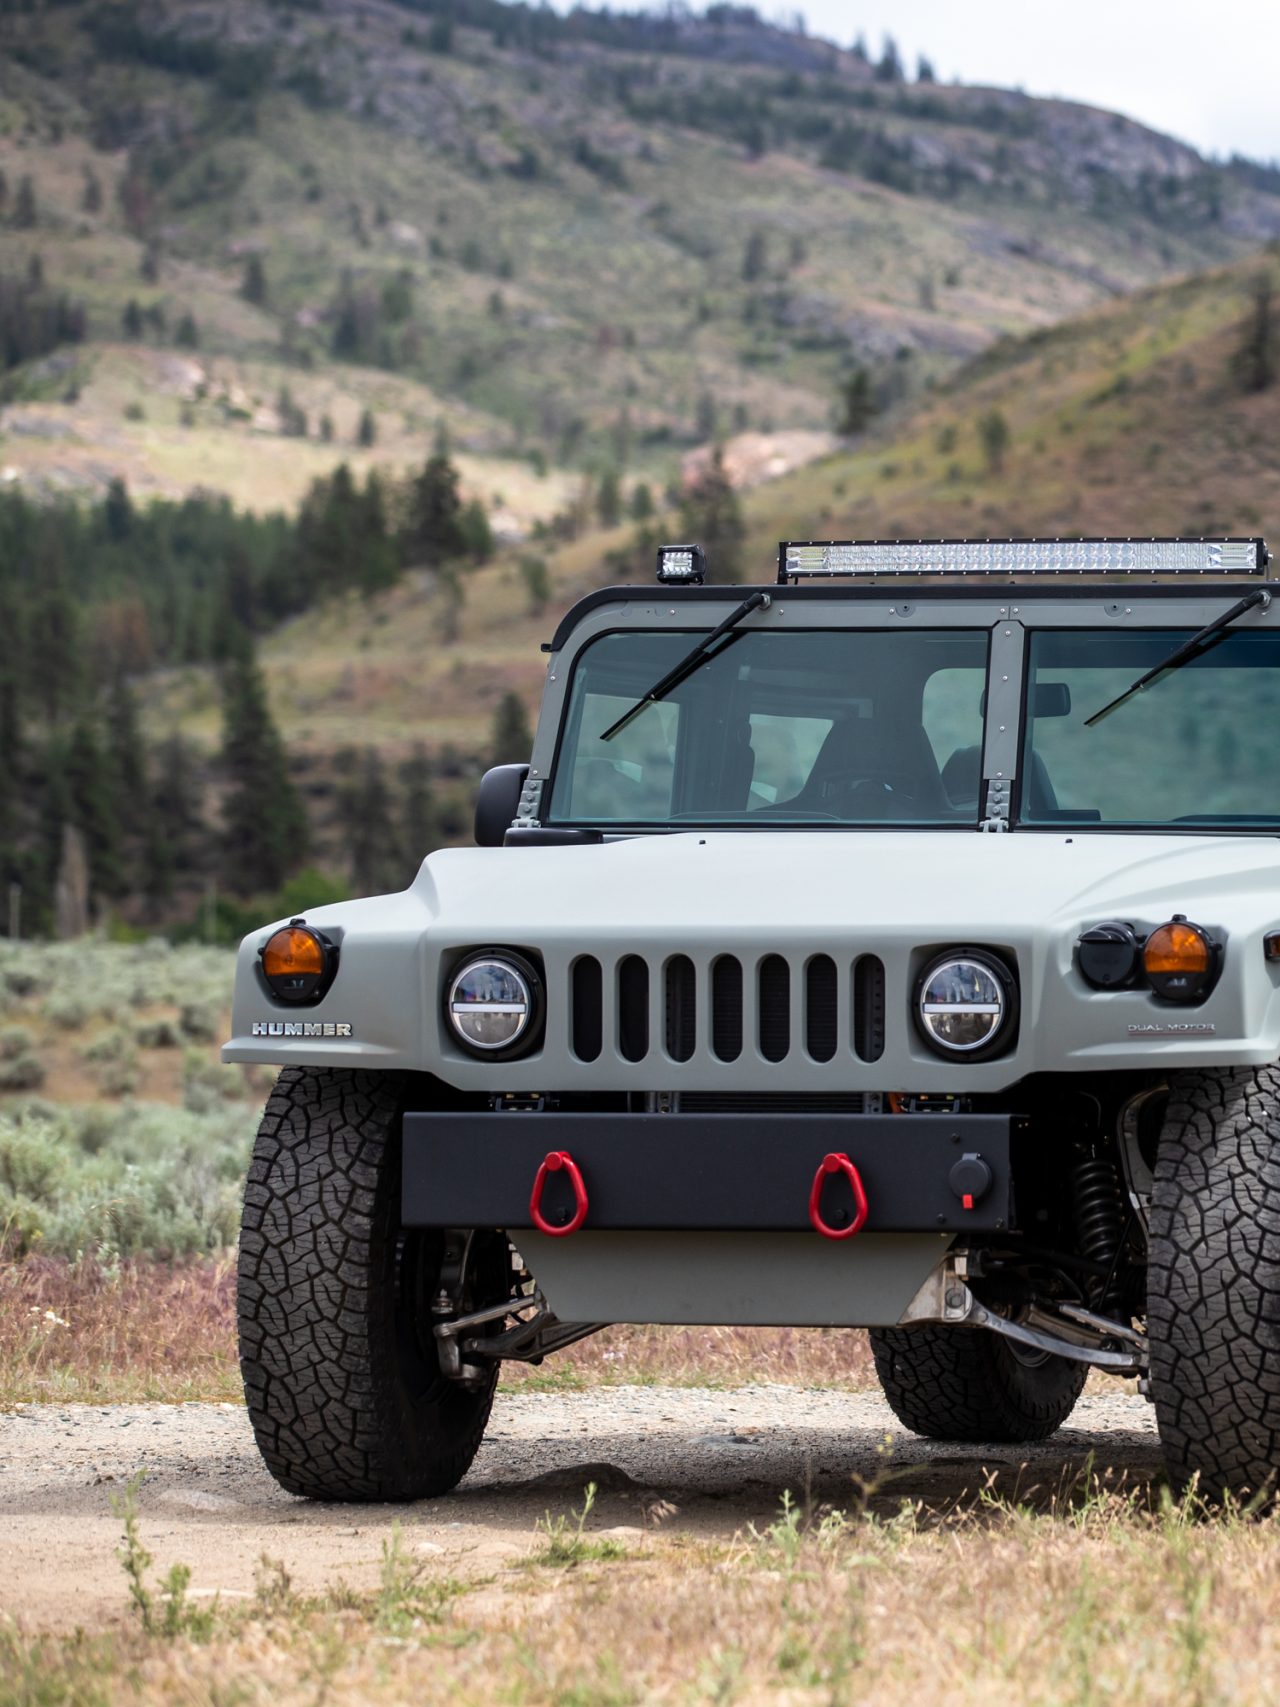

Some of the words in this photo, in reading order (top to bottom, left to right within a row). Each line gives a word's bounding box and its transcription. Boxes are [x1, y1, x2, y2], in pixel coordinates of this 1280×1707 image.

[252, 1023, 352, 1036] HUMMER
[1127, 1024, 1164, 1032] DUAL
[1167, 1023, 1216, 1031] MOTOR
